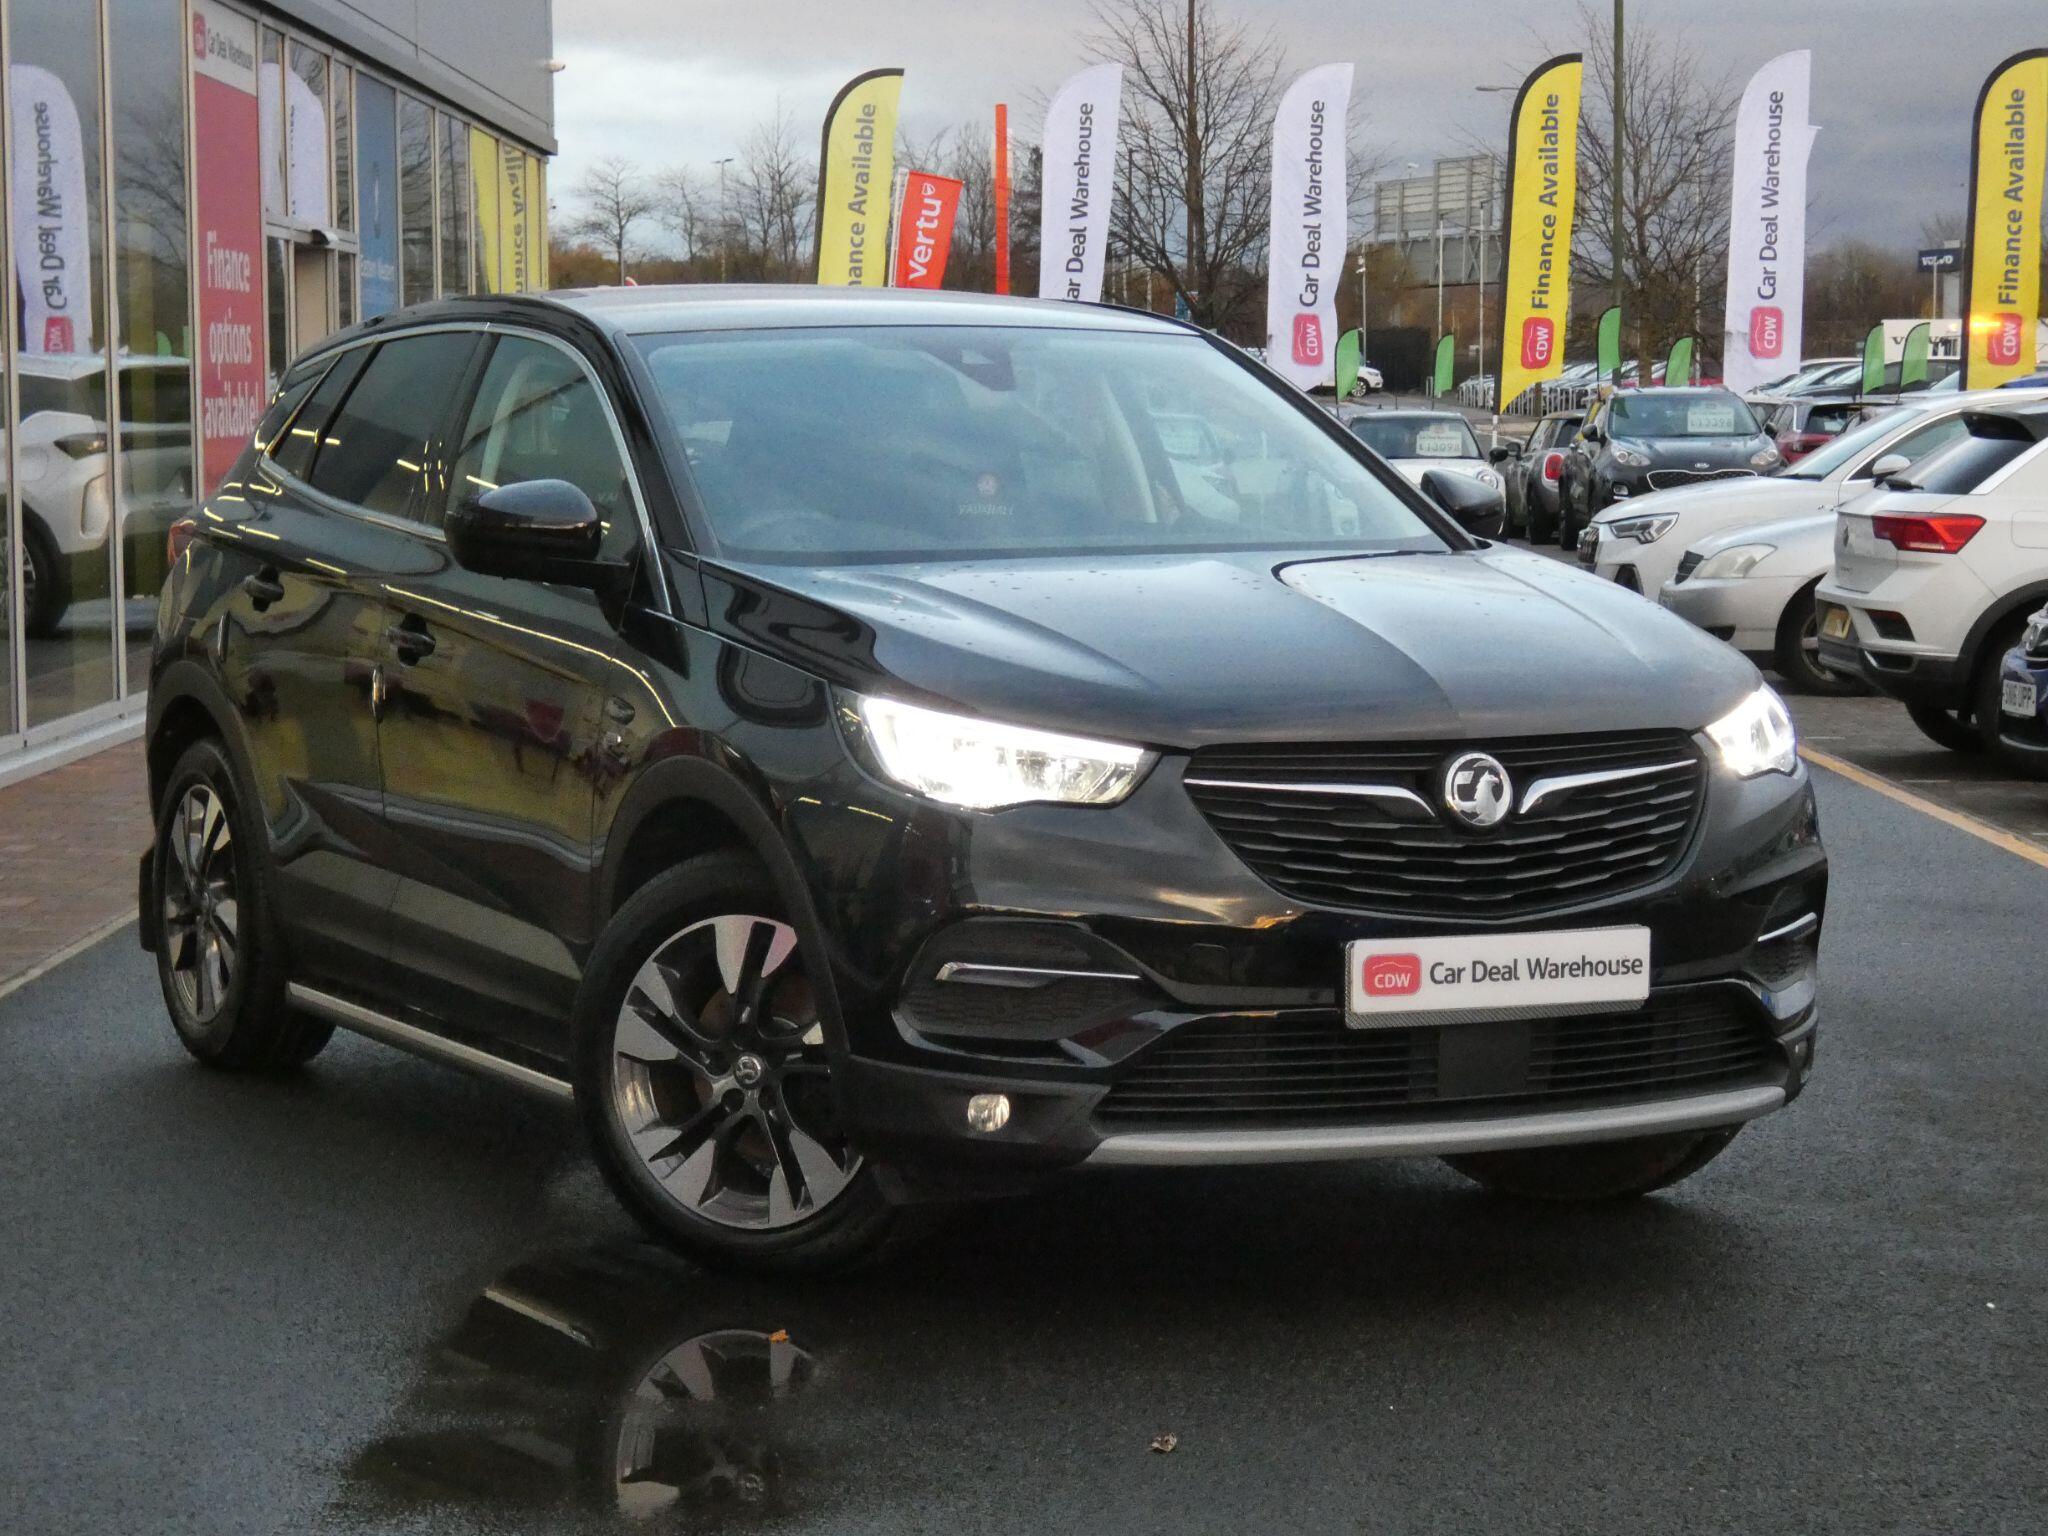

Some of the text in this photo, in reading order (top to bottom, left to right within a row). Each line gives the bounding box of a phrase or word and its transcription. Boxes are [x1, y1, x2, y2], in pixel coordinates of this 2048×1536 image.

[206, 230, 250, 293] Finance
[847, 103, 877, 287] ance Available
[908, 196, 943, 280] Vertu
[1065, 102, 1094, 301] ar Deal Warehouse
[1299, 100, 1325, 357] CDW Car Deal Warehouse
[1531, 93, 1559, 361] CDW Finance Available
[1757, 90, 1784, 350] CDW Car Deal Warehouse
[1998, 88, 2025, 357] CDW Finance Available
[208, 307, 253, 381] options
[1373, 954, 1643, 989] CDW Car Deal Warehouse
